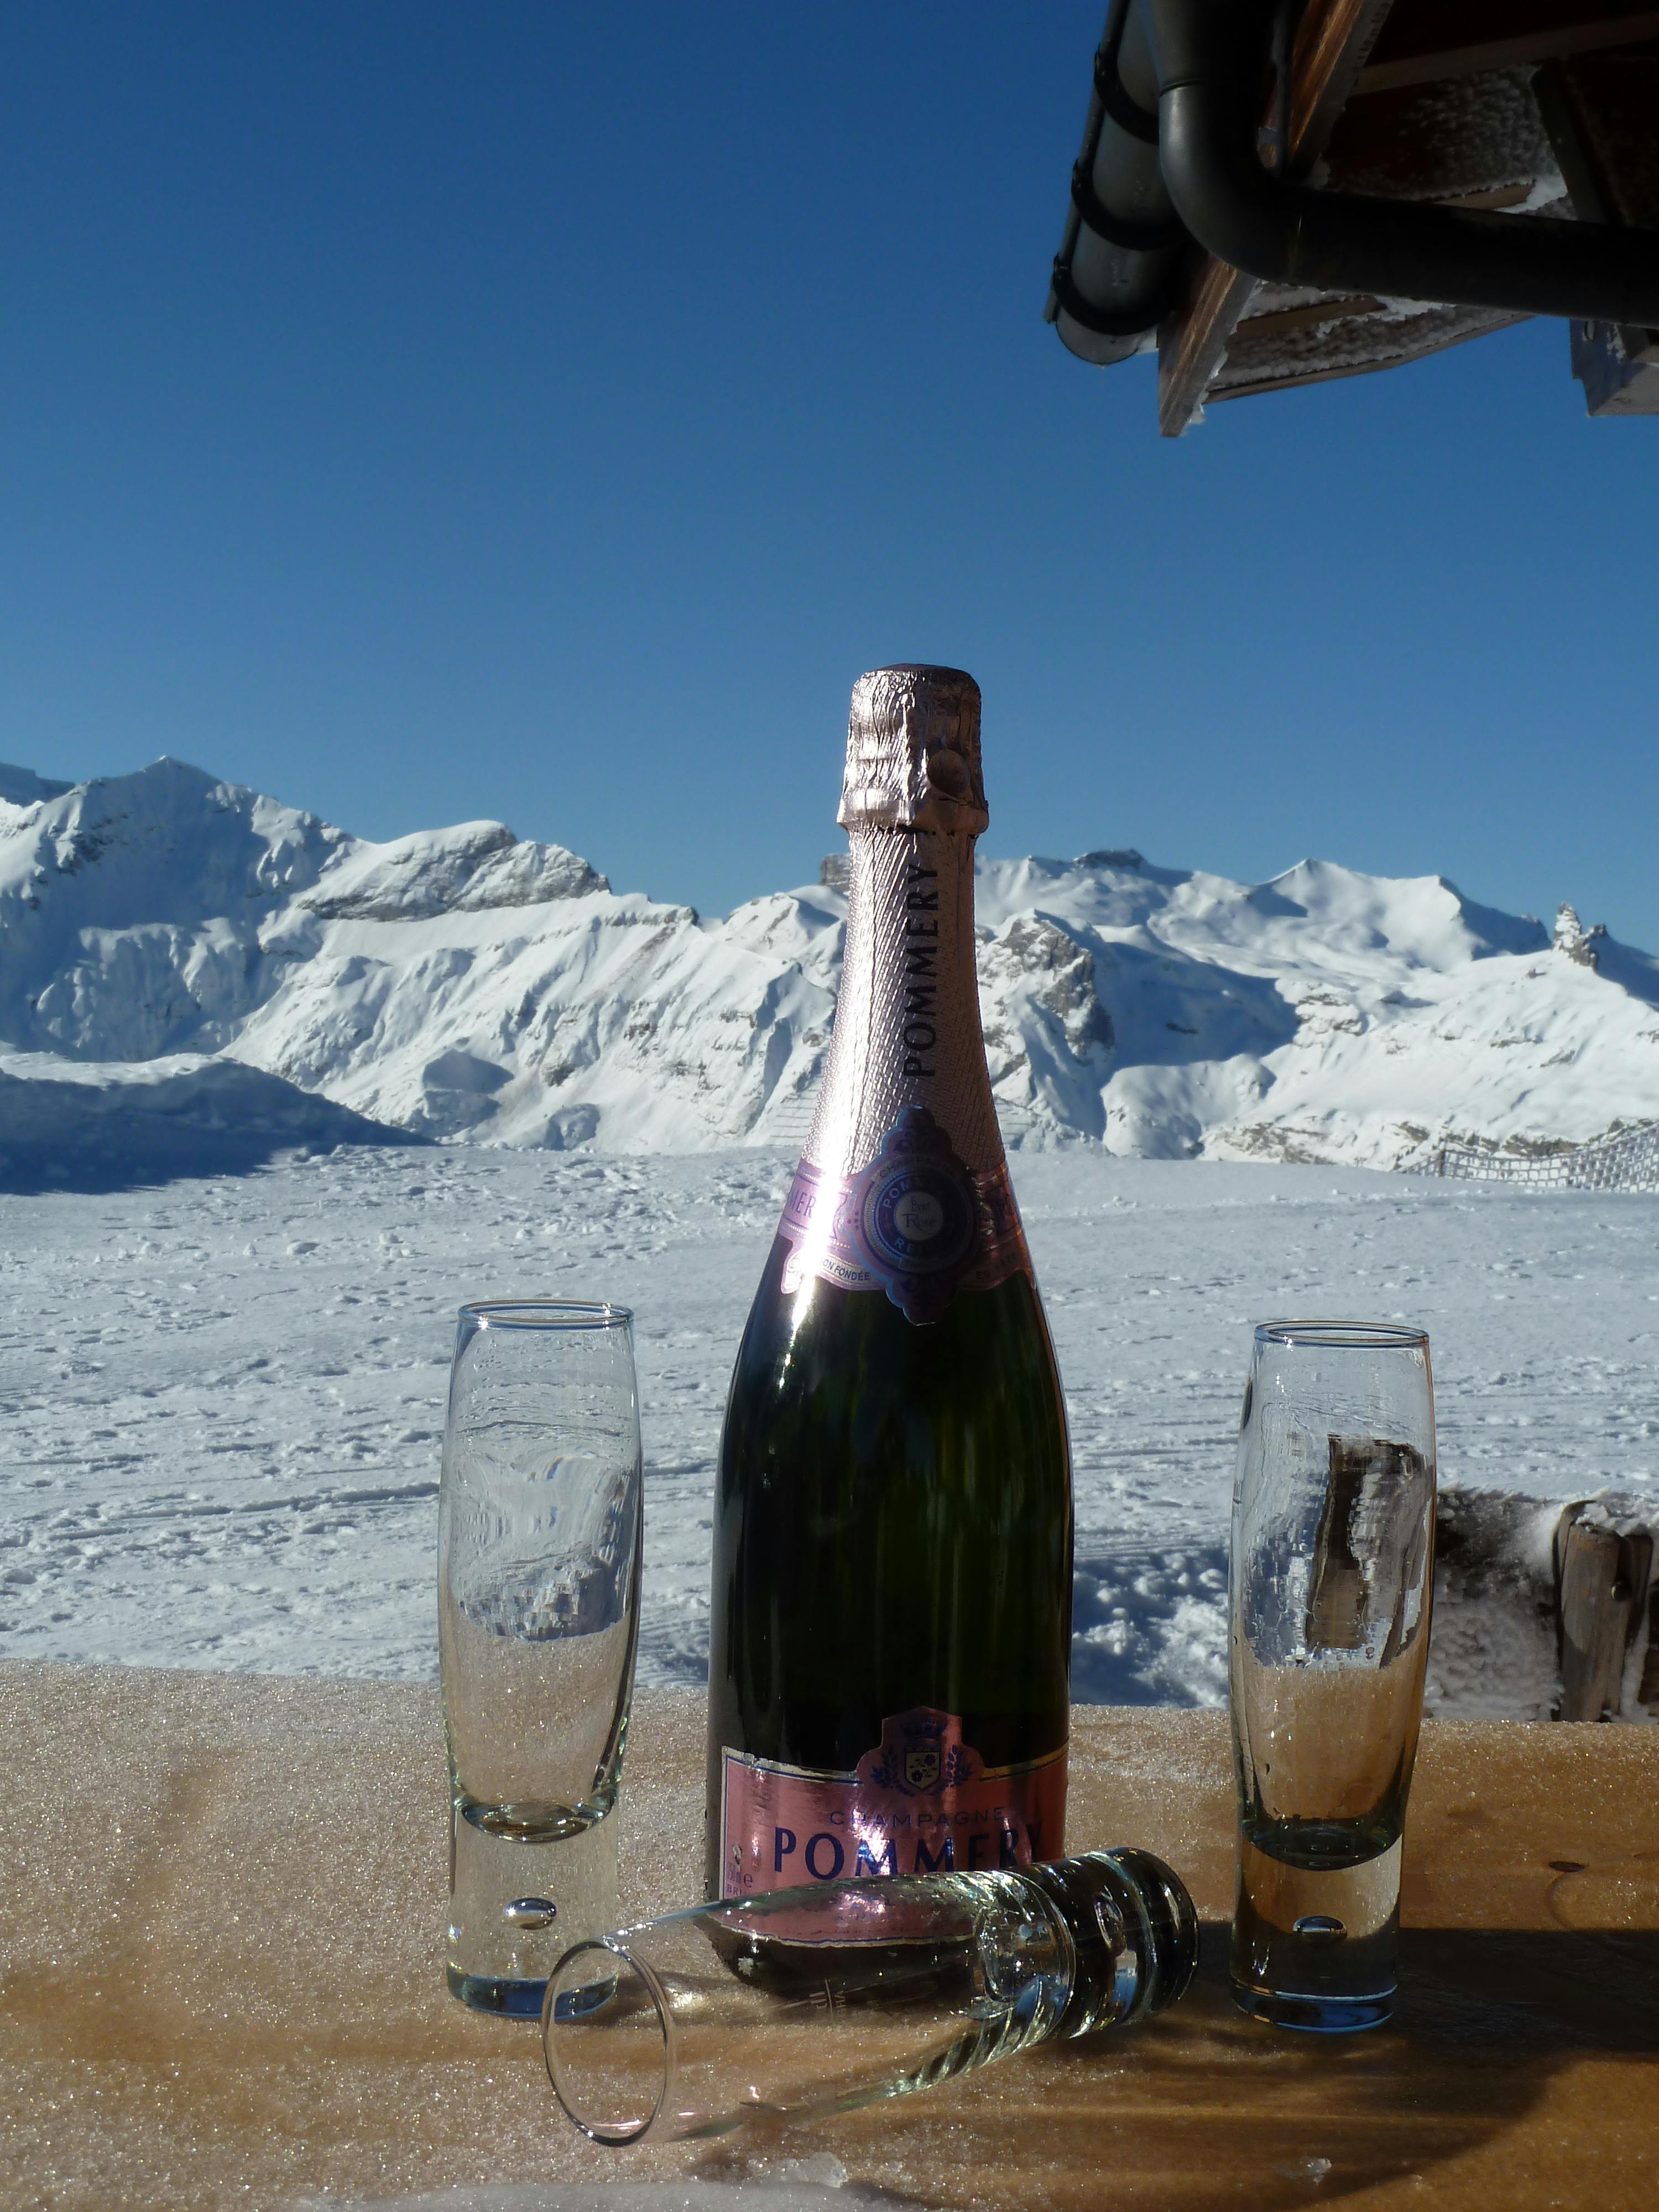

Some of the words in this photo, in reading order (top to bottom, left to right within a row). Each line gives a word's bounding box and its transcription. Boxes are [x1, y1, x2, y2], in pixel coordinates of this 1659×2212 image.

[903, 863, 939, 1077] POMMERY
[830, 1806, 1006, 1828] CHAMPAGNE
[775, 1823, 1043, 1880] POMMERY
